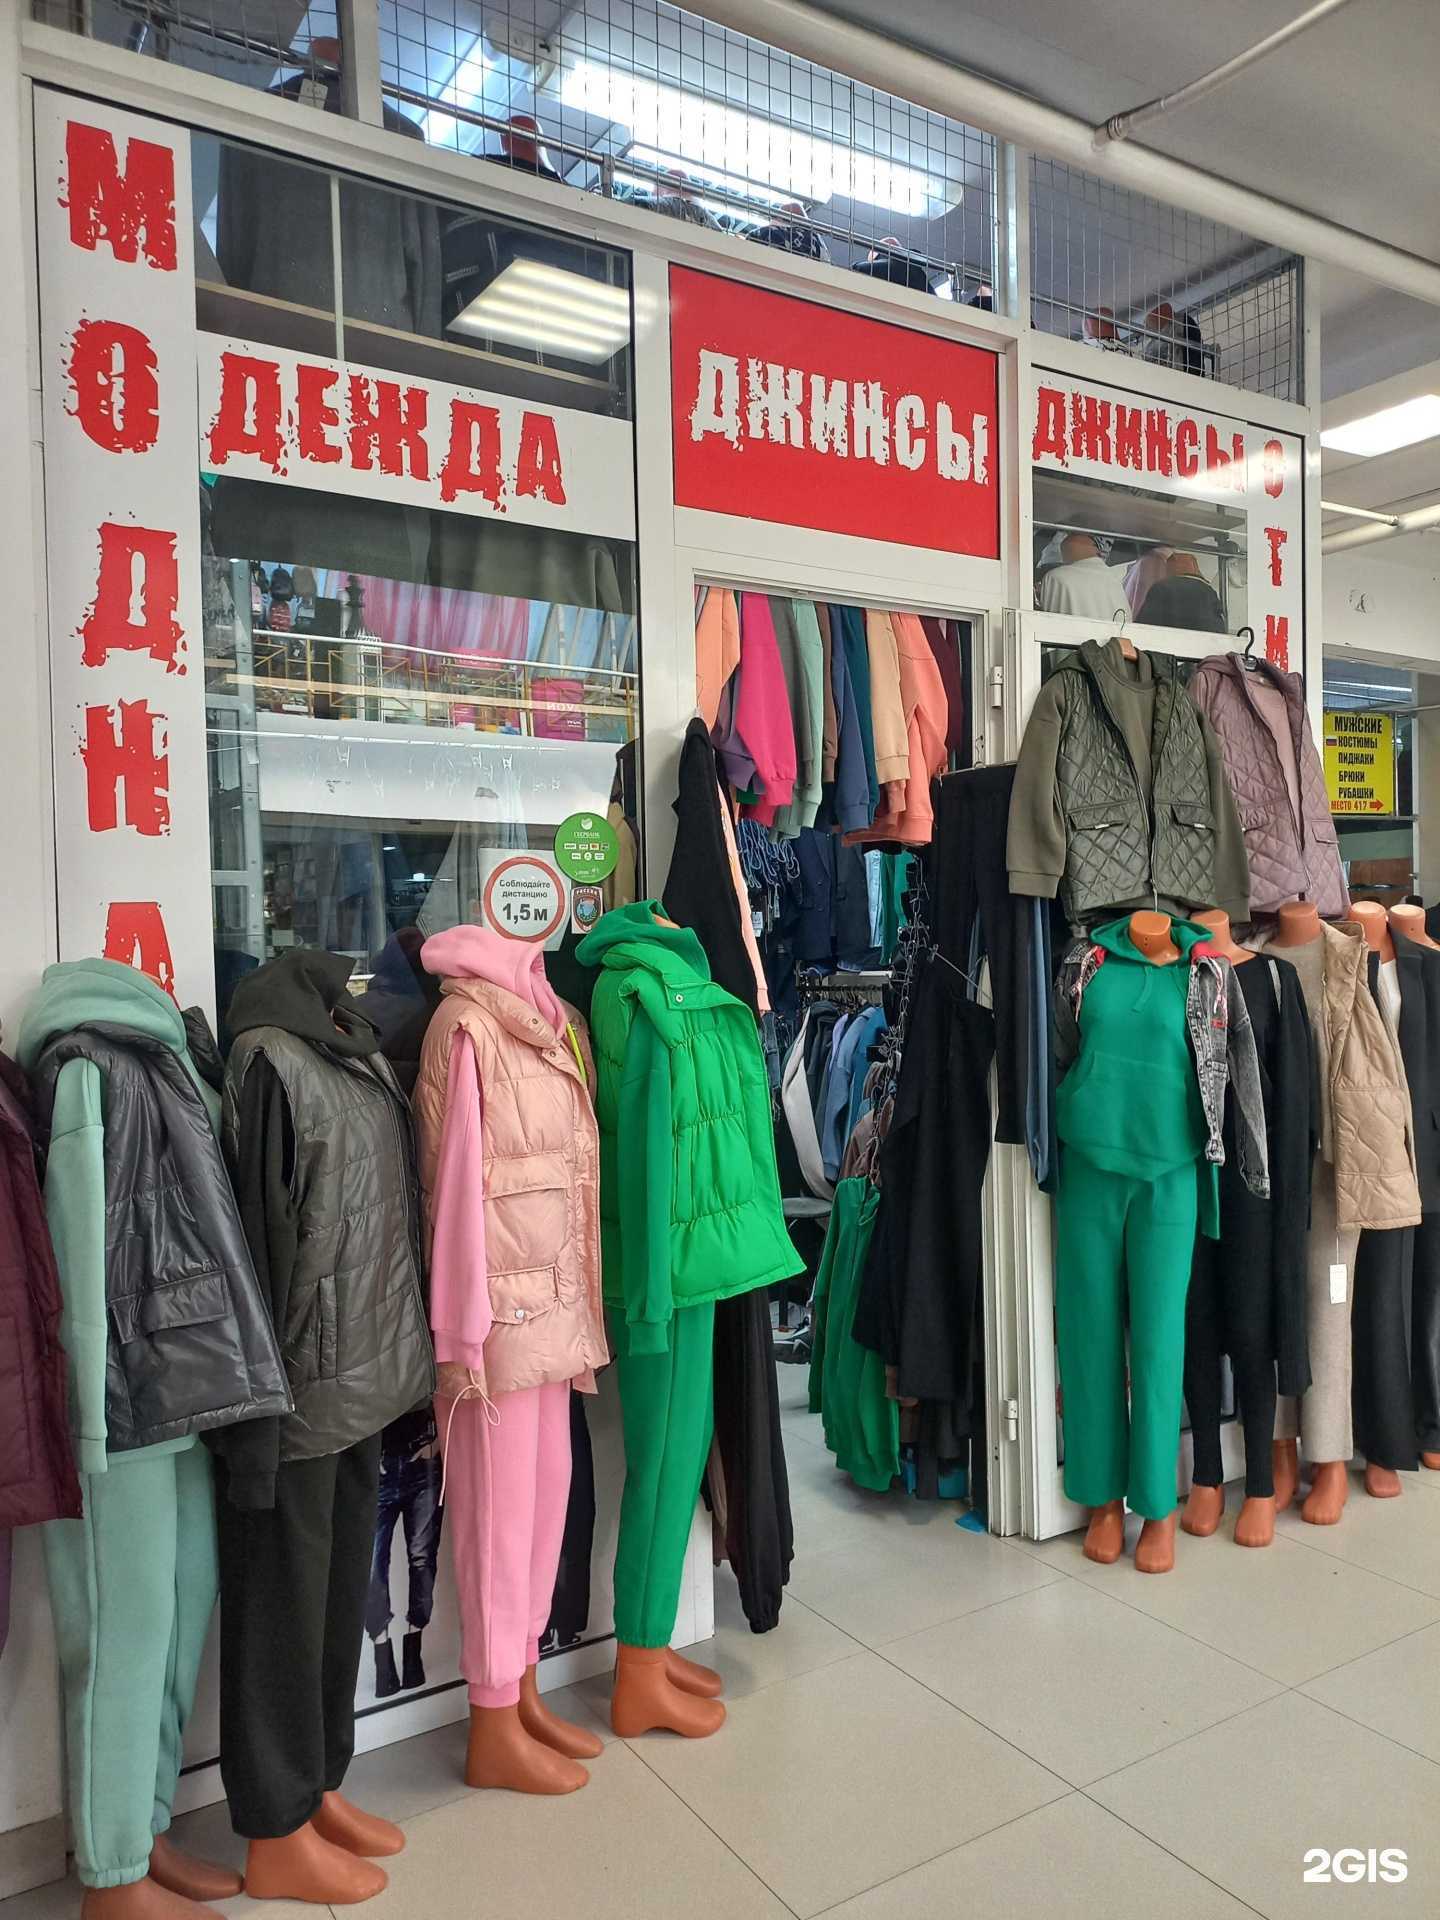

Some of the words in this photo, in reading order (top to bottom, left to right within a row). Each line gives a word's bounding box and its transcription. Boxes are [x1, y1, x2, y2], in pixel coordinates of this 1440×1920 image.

[689, 347, 989, 486] ДЖИНСЫ
[1032, 386, 1245, 493] ДЖИНСЫ
[1334, 716, 1382, 733] МУЖСКИЕ
[1338, 736, 1378, 748] КОСТЮМЫ
[1338, 752, 1375, 765] ПИДЖАКИ
[1338, 770, 1365, 782] БРЮКИ
[1338, 787, 1374, 799] РУБАШКИ
[1330, 800, 1352, 810] МЕСТО
[1354, 800, 1367, 811] 417
[499, 879, 551, 889] Соблюдайте
[502, 890, 548, 900] дистанцию
[502, 903, 531, 924] 1,5
[534, 909, 548, 921] м
